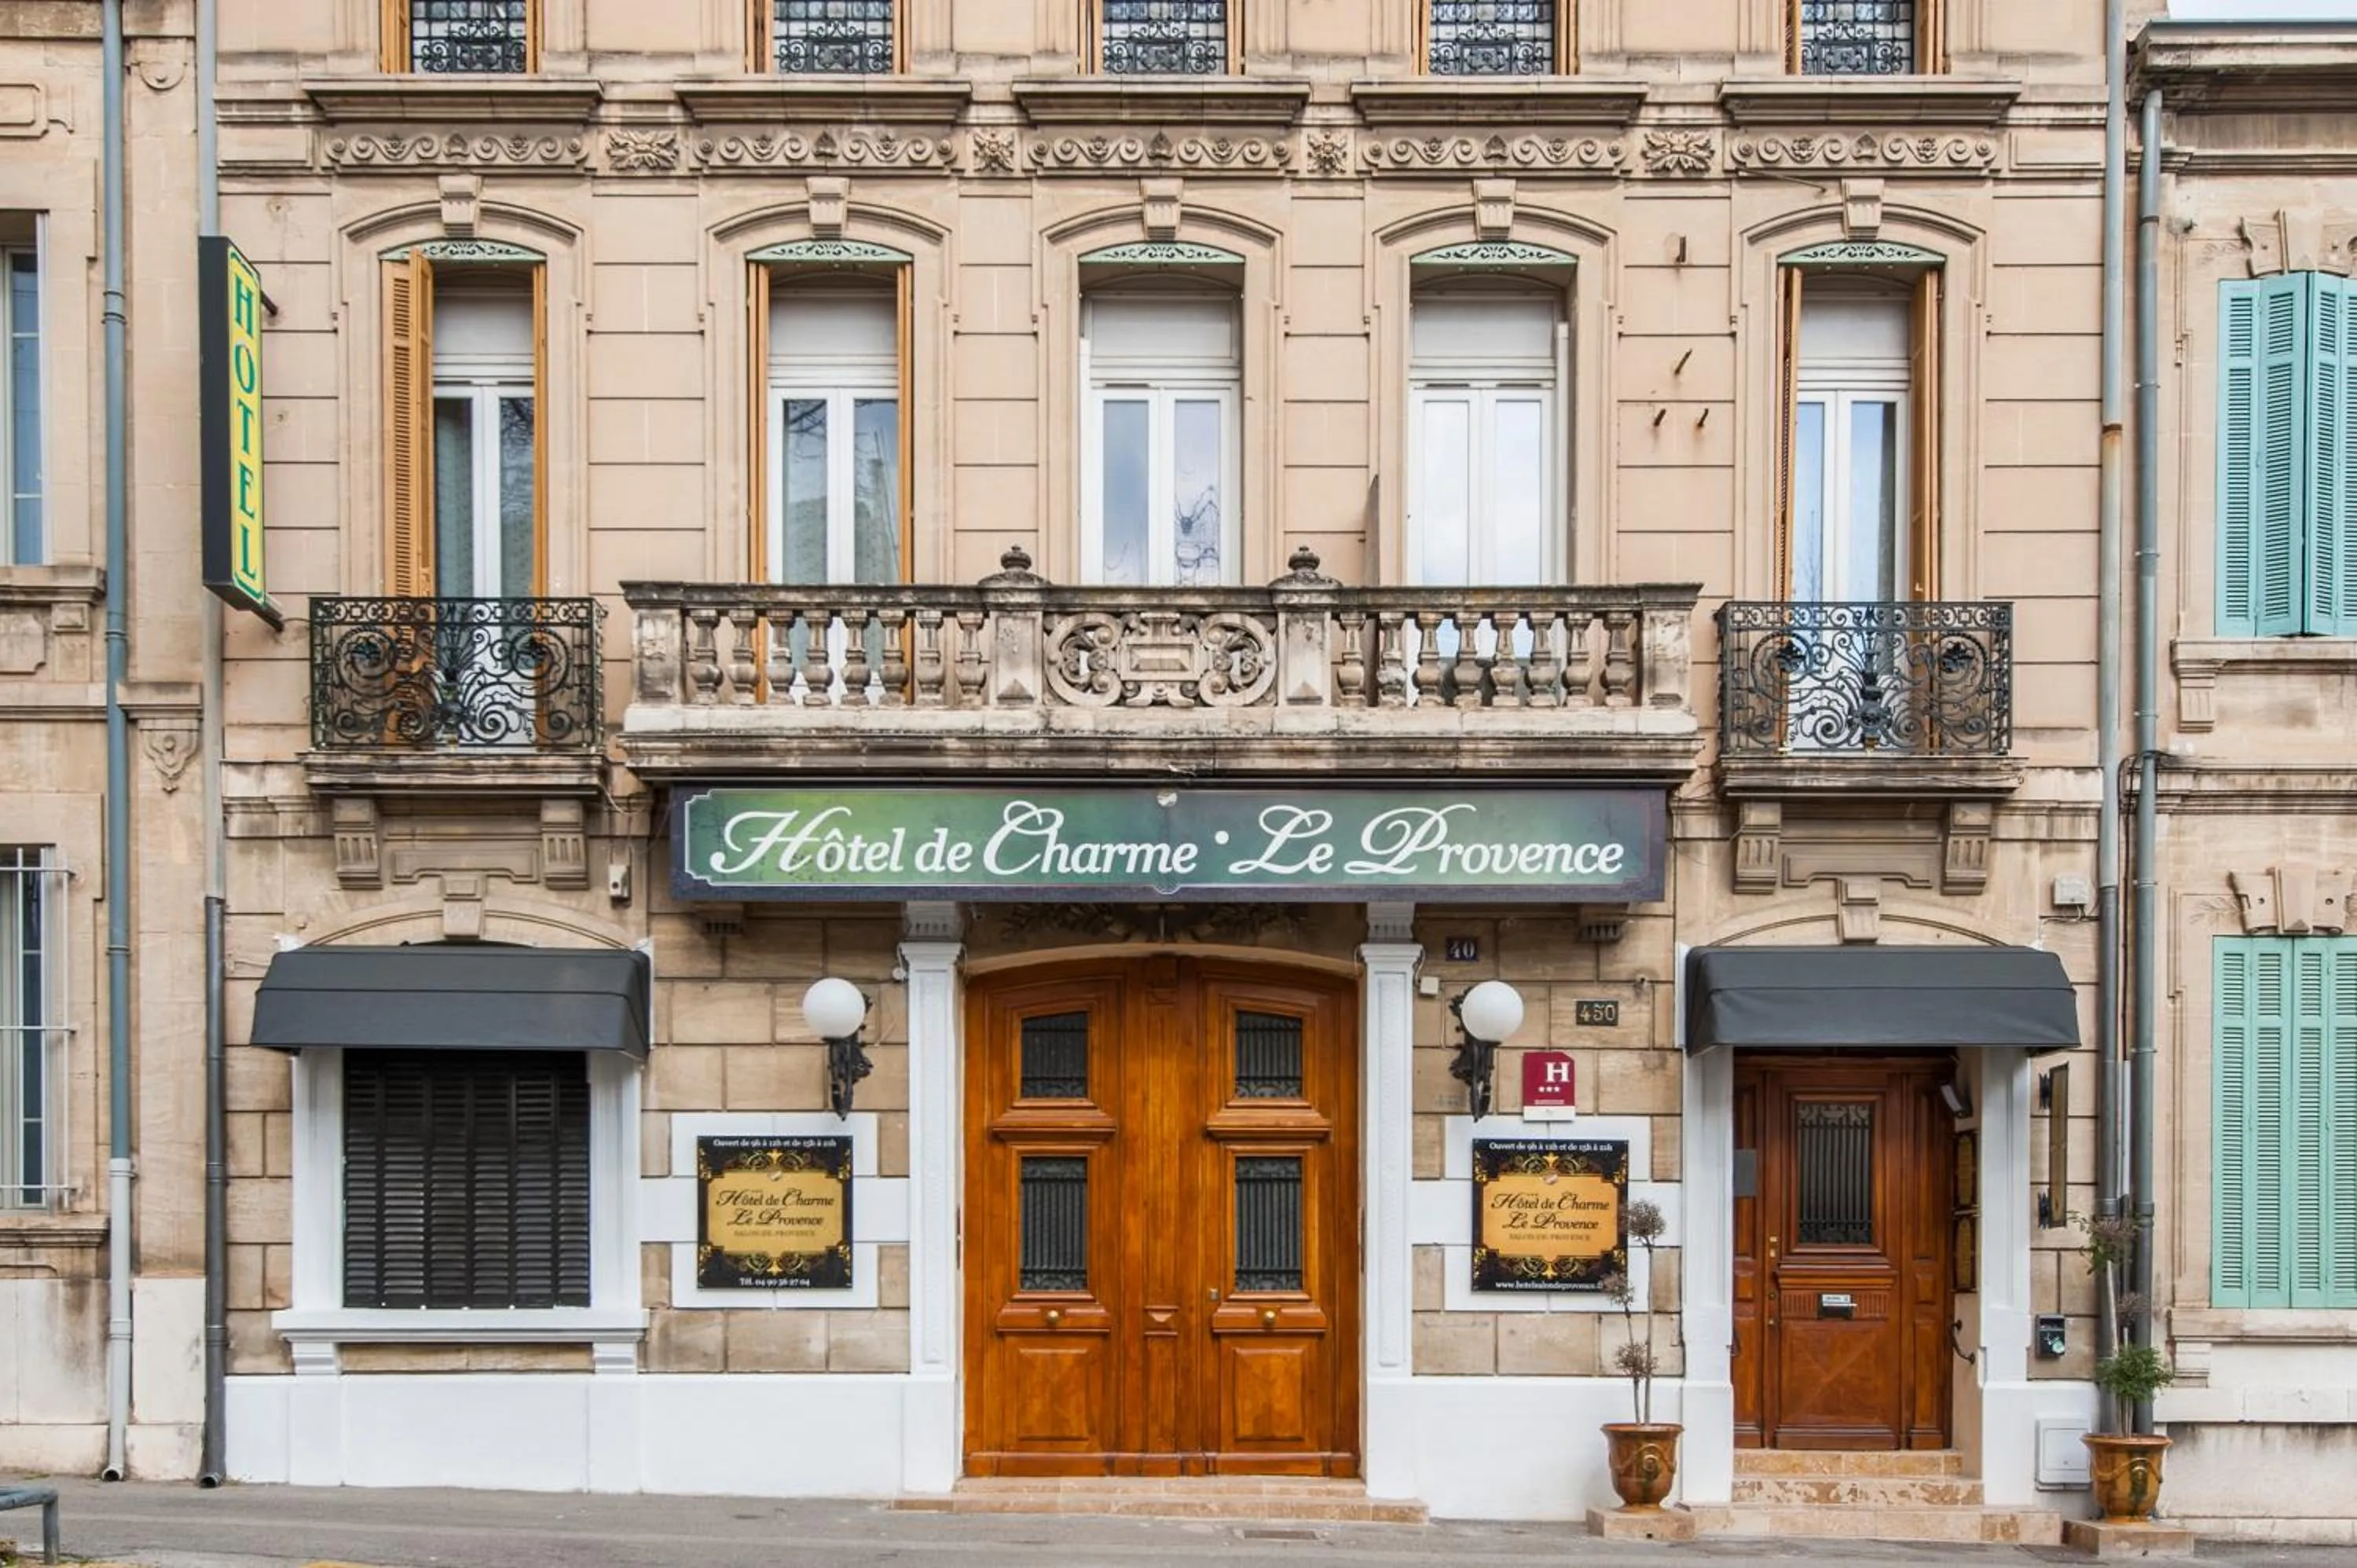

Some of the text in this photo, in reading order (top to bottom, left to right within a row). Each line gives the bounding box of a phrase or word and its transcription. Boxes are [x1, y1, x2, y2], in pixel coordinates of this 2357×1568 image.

[234, 273, 256, 581] HOTEL
[709, 800, 1625, 875] Hôtel de Charme Le Provence
[1450, 941, 1475, 959] 40
[1579, 1004, 1616, 1021] 450
[1545, 1061, 1571, 1083] H
[716, 1187, 834, 1207] Hôtel de Charme
[1490, 1191, 1610, 1211] Hôtel de Charme
[727, 1207, 824, 1225] Le Provence
[1502, 1211, 1599, 1229] Le Provence
